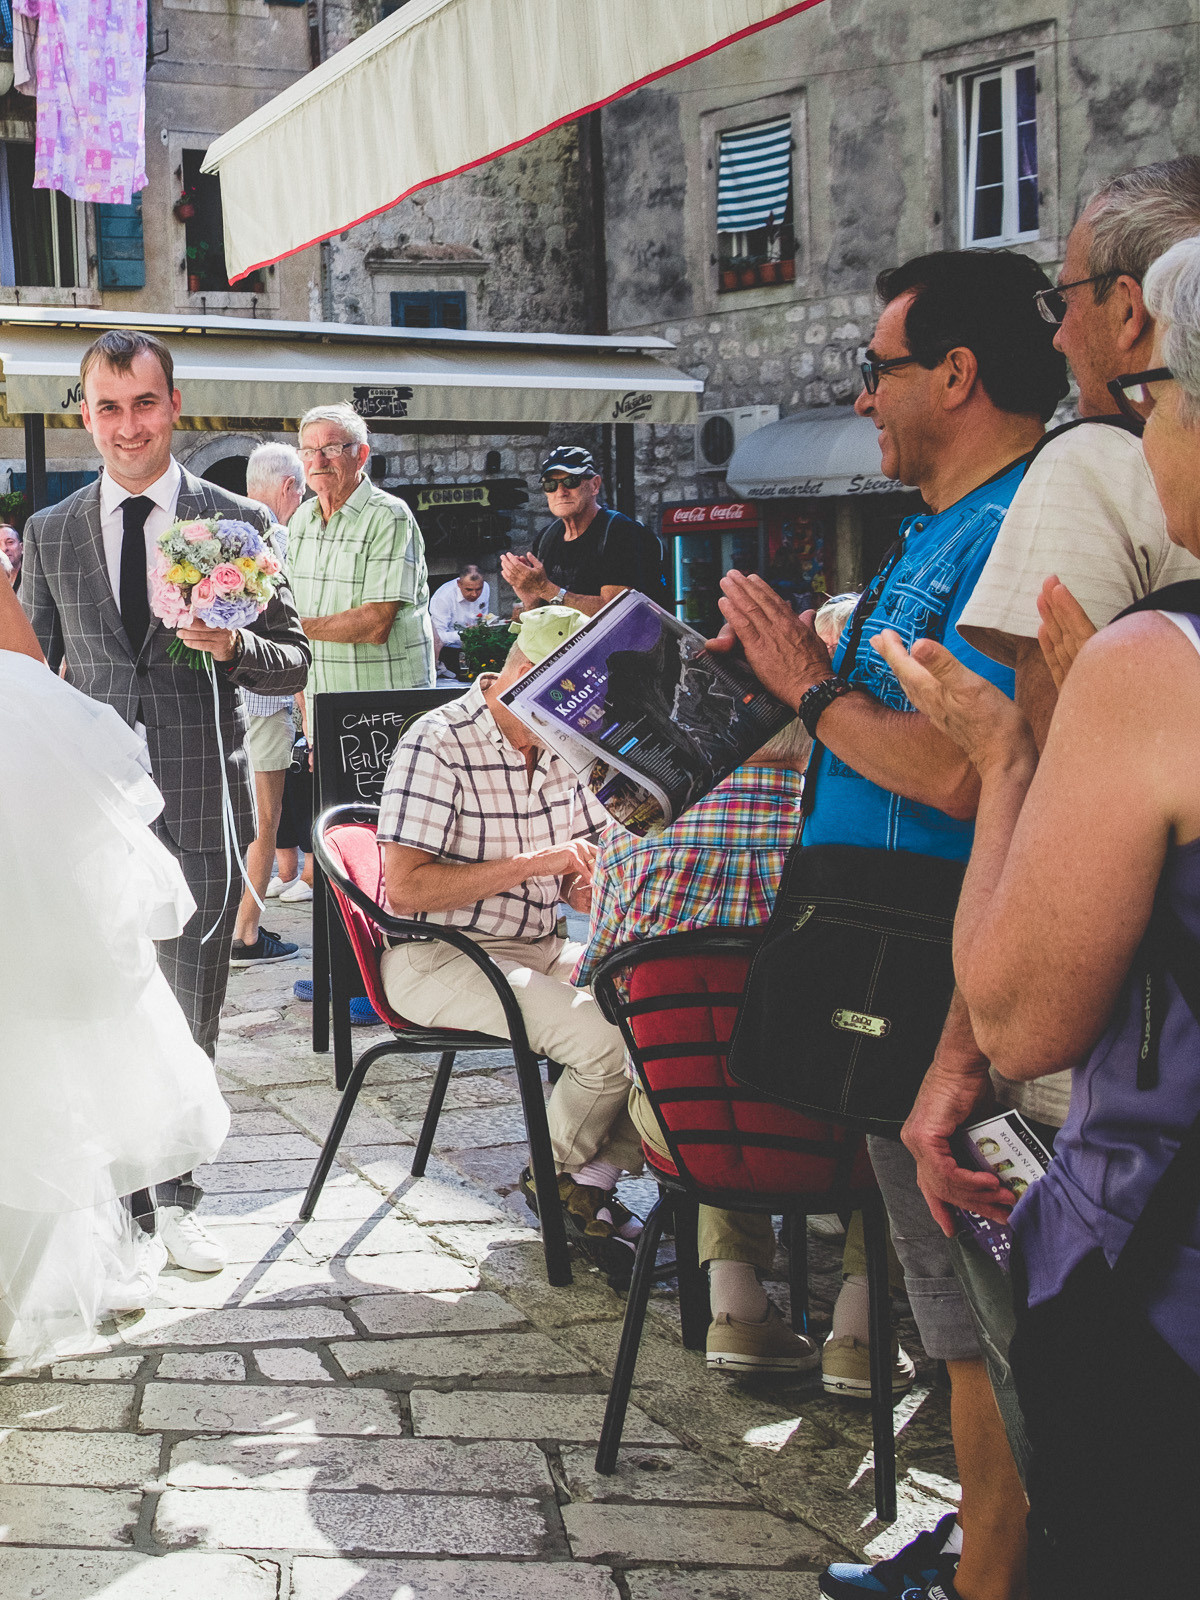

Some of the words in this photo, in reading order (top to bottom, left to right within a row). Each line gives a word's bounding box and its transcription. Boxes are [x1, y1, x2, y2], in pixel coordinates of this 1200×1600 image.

[421, 488, 484, 504] KONOBA
[748, 484, 778, 496] mini
[778, 479, 824, 496] market
[554, 683, 595, 717] Kotor
[342, 712, 405, 729] CAFFE
[999, 1130, 1022, 1158] KOTOR
[932, 1585, 949, 1600] NIK
